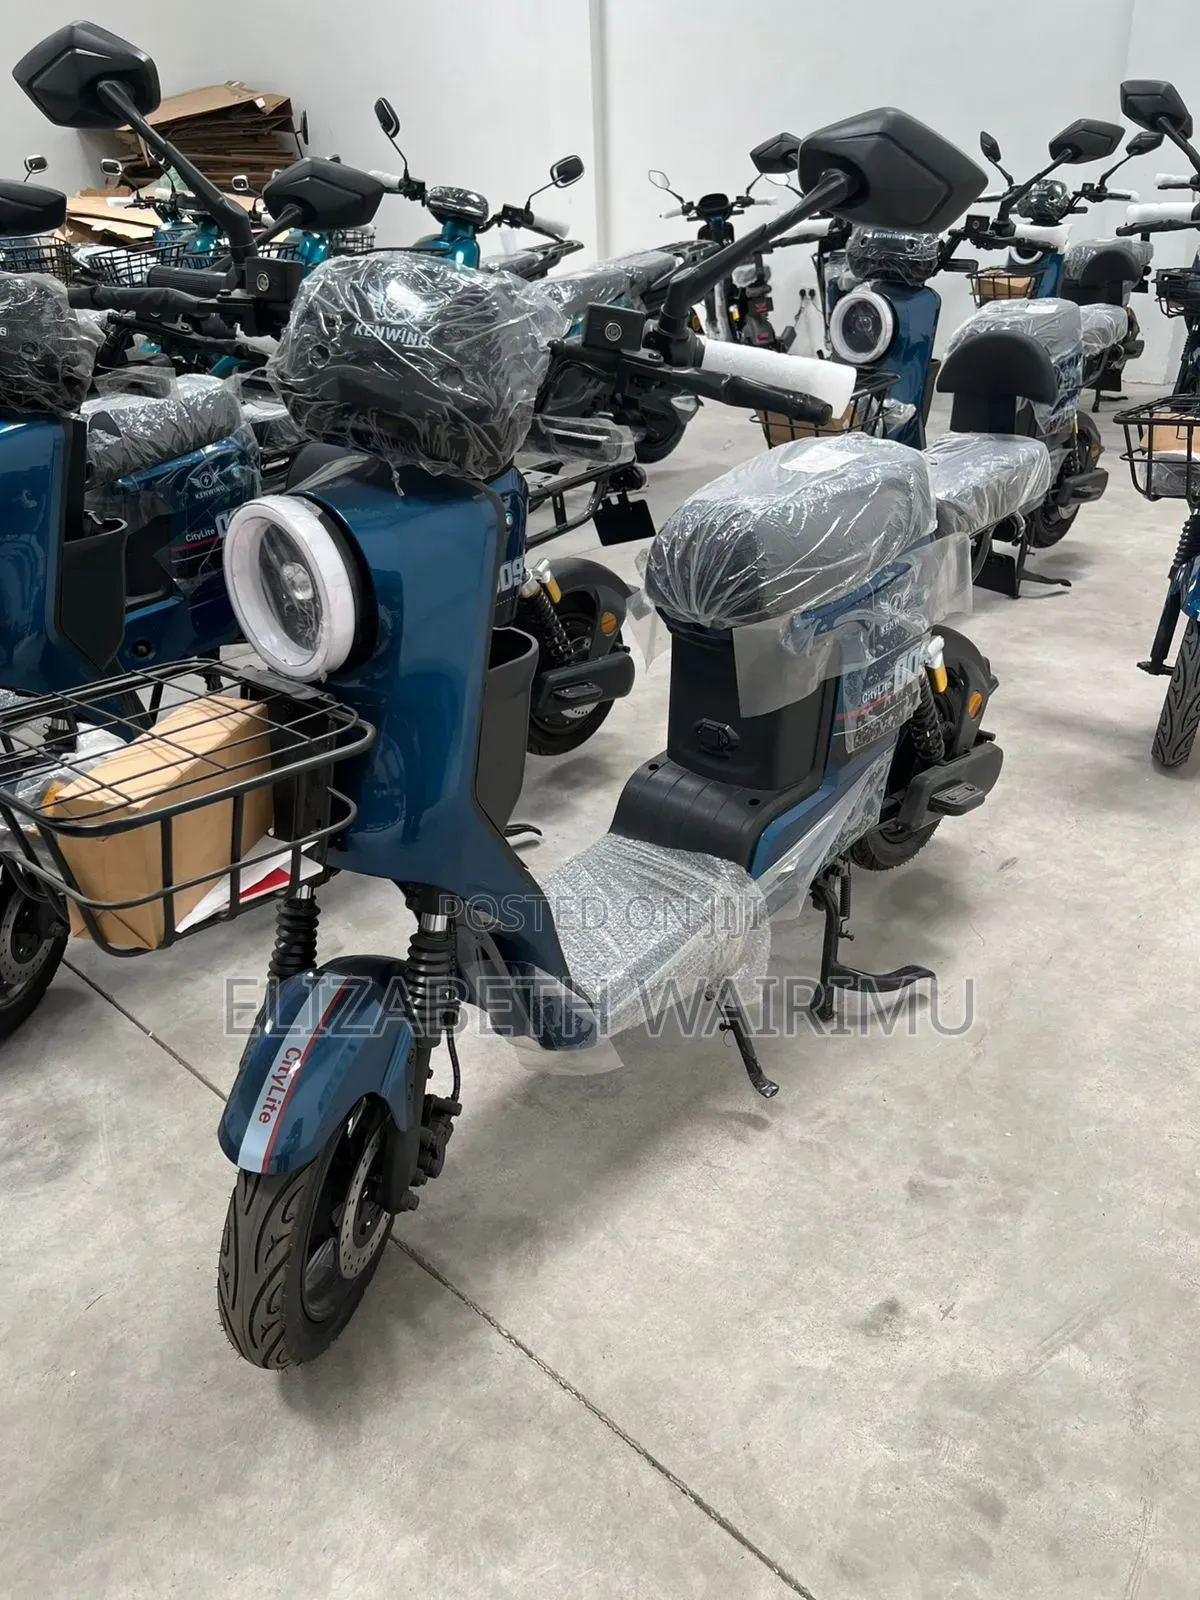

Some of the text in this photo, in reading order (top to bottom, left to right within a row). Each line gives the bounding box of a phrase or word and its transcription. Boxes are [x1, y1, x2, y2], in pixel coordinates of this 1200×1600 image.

[353, 322, 431, 348] KENWING
[185, 528, 216, 542] CityLite
[258, 1047, 302, 1124] CityLite
